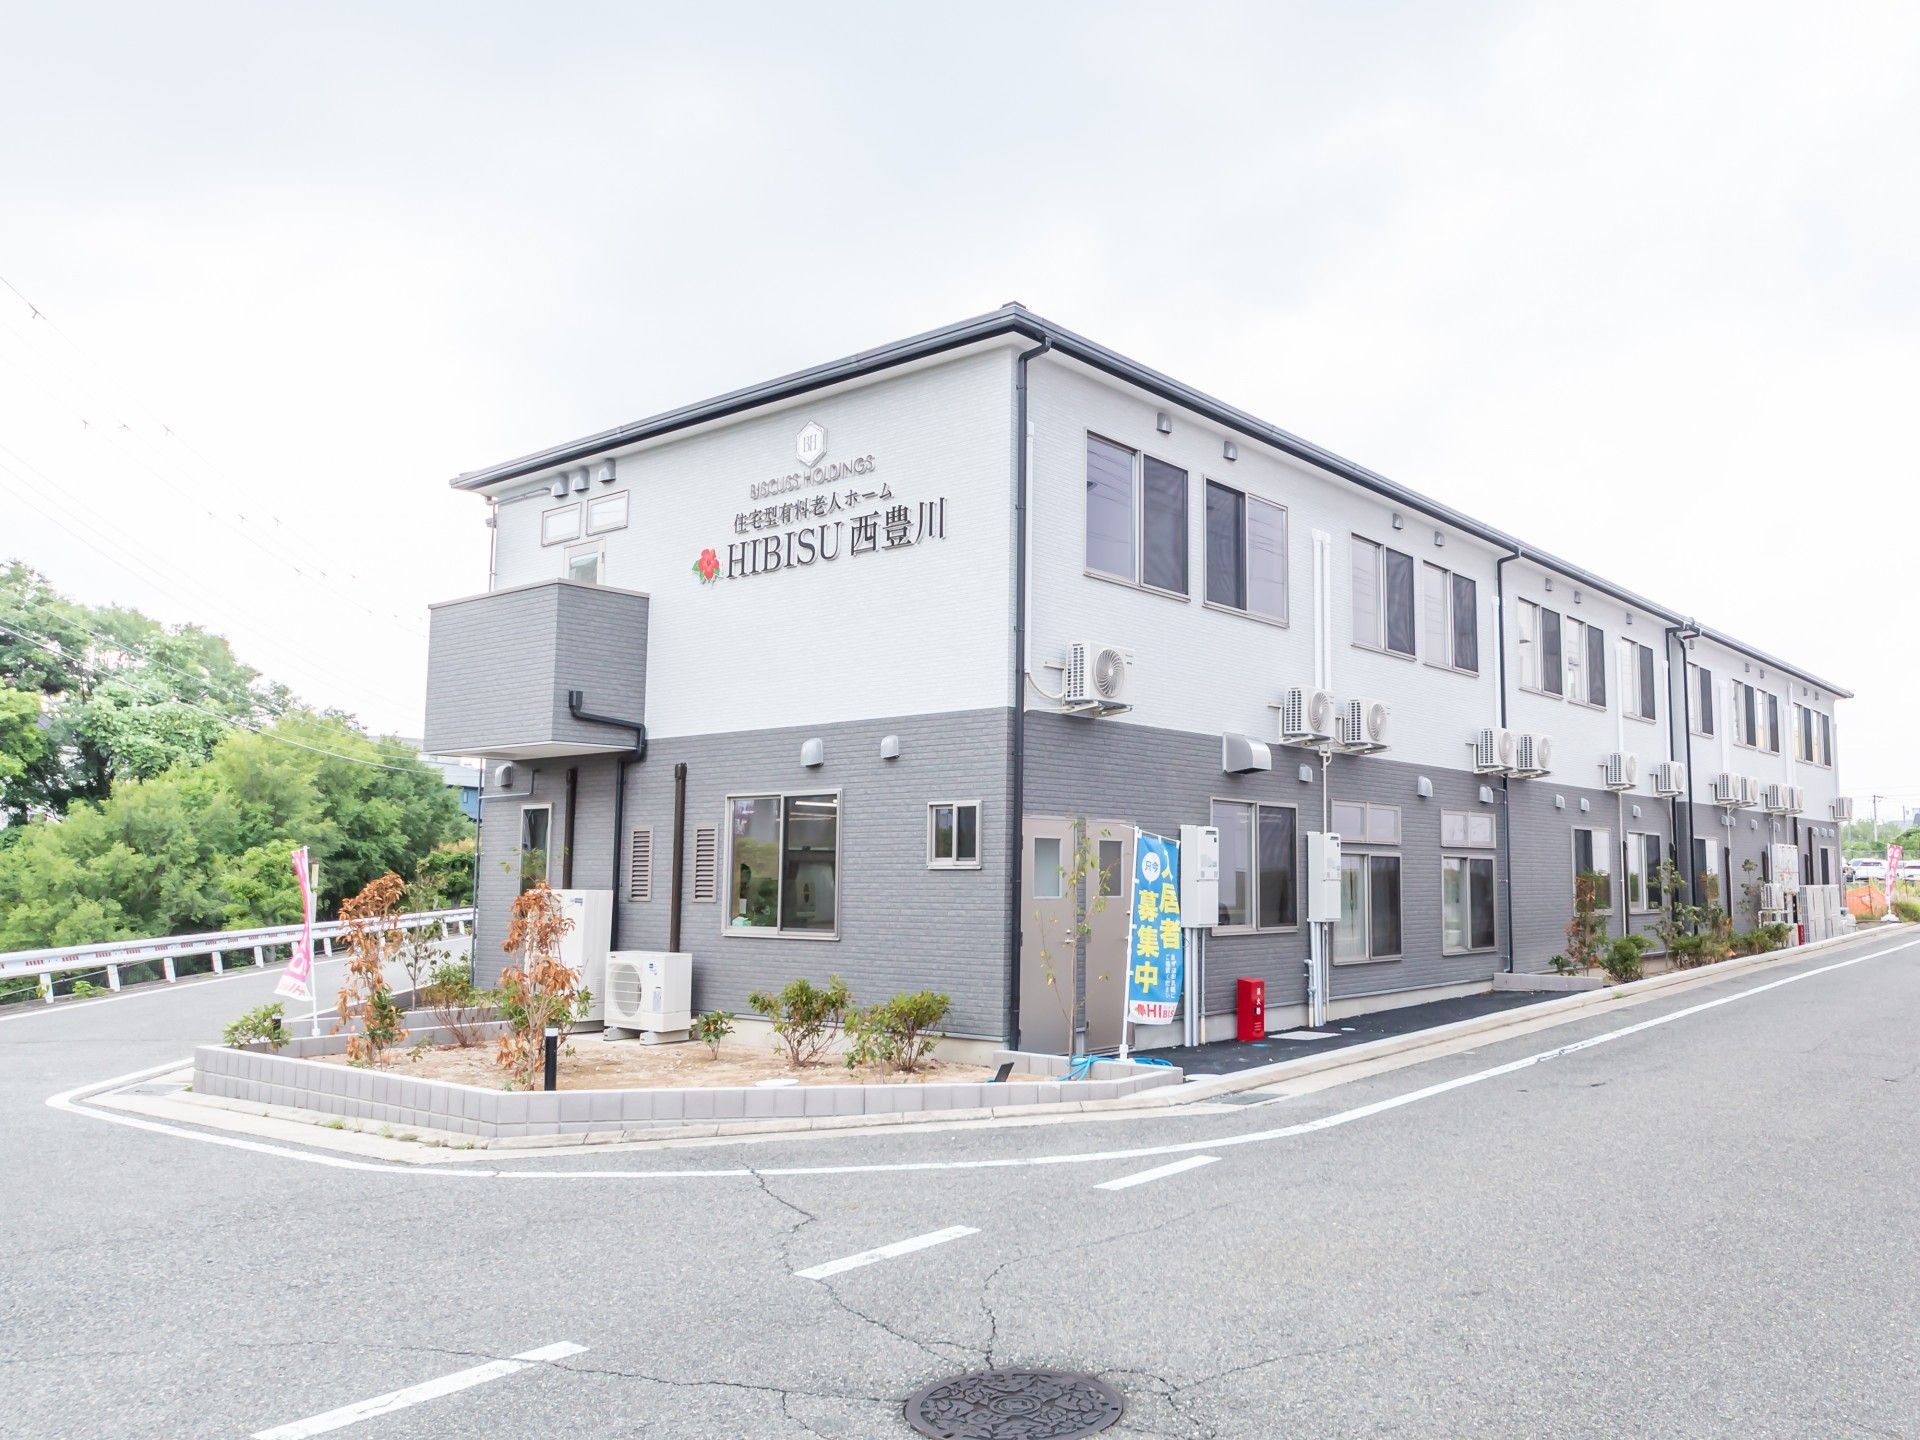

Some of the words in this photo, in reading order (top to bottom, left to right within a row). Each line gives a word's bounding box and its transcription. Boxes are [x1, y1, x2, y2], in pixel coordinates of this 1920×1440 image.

[734, 482, 894, 534] 住宅型有料老人ホーム
[750, 474, 800, 500] BISCUSS
[803, 454, 875, 486] HOLDINGS
[727, 520, 844, 579] HIBISU
[849, 496, 947, 556] 西豊川
[1134, 889, 1160, 993] 募集中
[1159, 849, 1181, 950] 入居者
